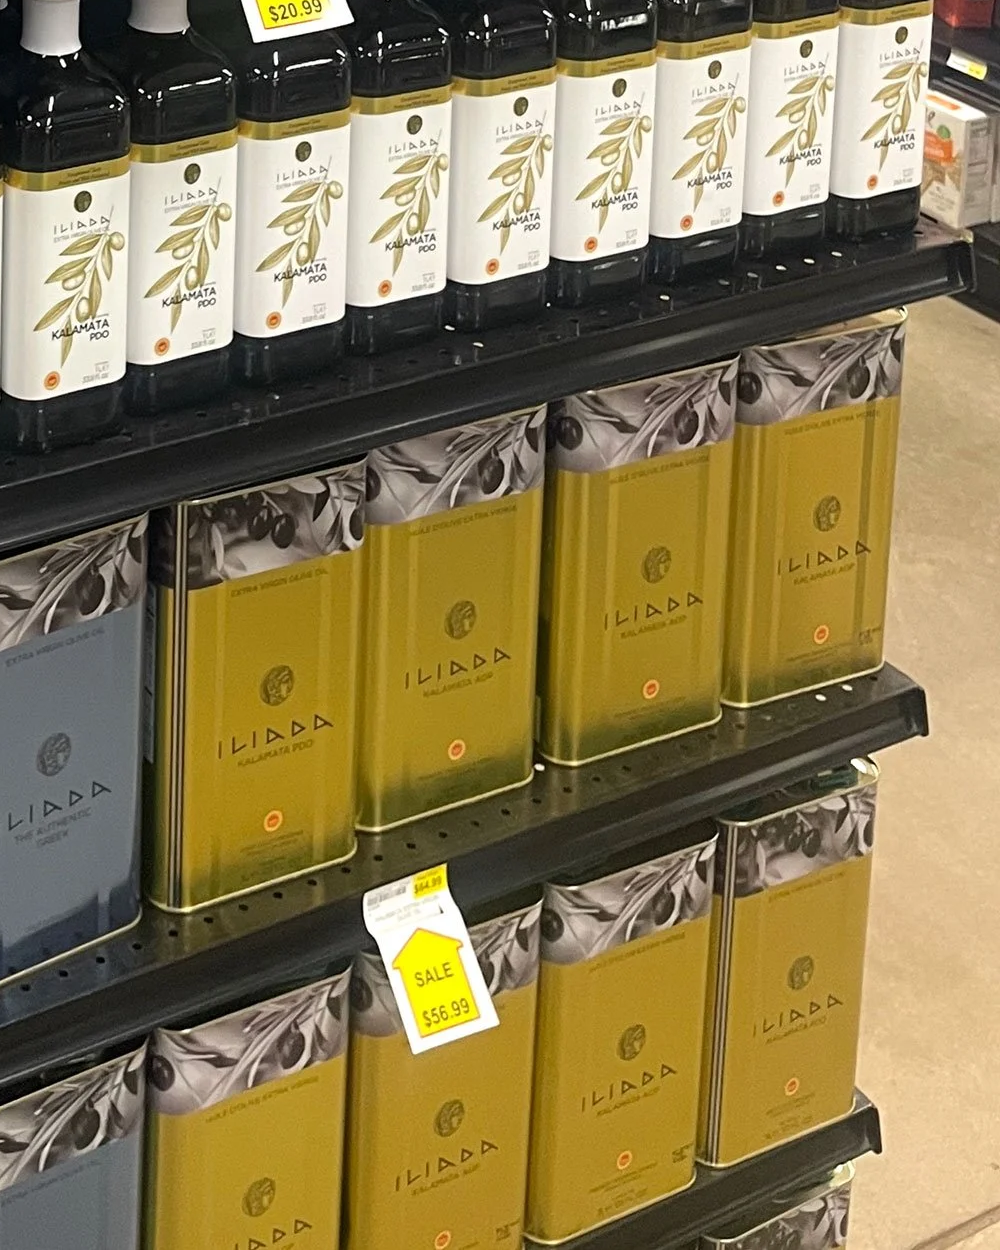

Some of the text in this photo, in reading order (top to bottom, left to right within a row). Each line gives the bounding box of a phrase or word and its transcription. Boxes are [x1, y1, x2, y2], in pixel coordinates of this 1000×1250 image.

[784, 60, 825, 76] ILIADA
[389, 138, 438, 154] ILIADA
[780, 149, 822, 166] KALAMATA
[164, 188, 217, 205] ILIADA
[385, 233, 436, 252] KALAMATA
[162, 286, 216, 307] KALAMATA
[777, 540, 871, 576] ILIADA
[605, 591, 703, 631] ILIADA
[405, 647, 510, 688] ILIADA
[219, 714, 333, 759] ILIADA
[414, 876, 441, 894] $64.99
[415, 962, 454, 987] SALE
[423, 998, 469, 1028] $56.99
[754, 993, 843, 1038] ILIADA
[582, 1063, 678, 1113] ILIADA
[396, 1139, 498, 1192] ILIADA
